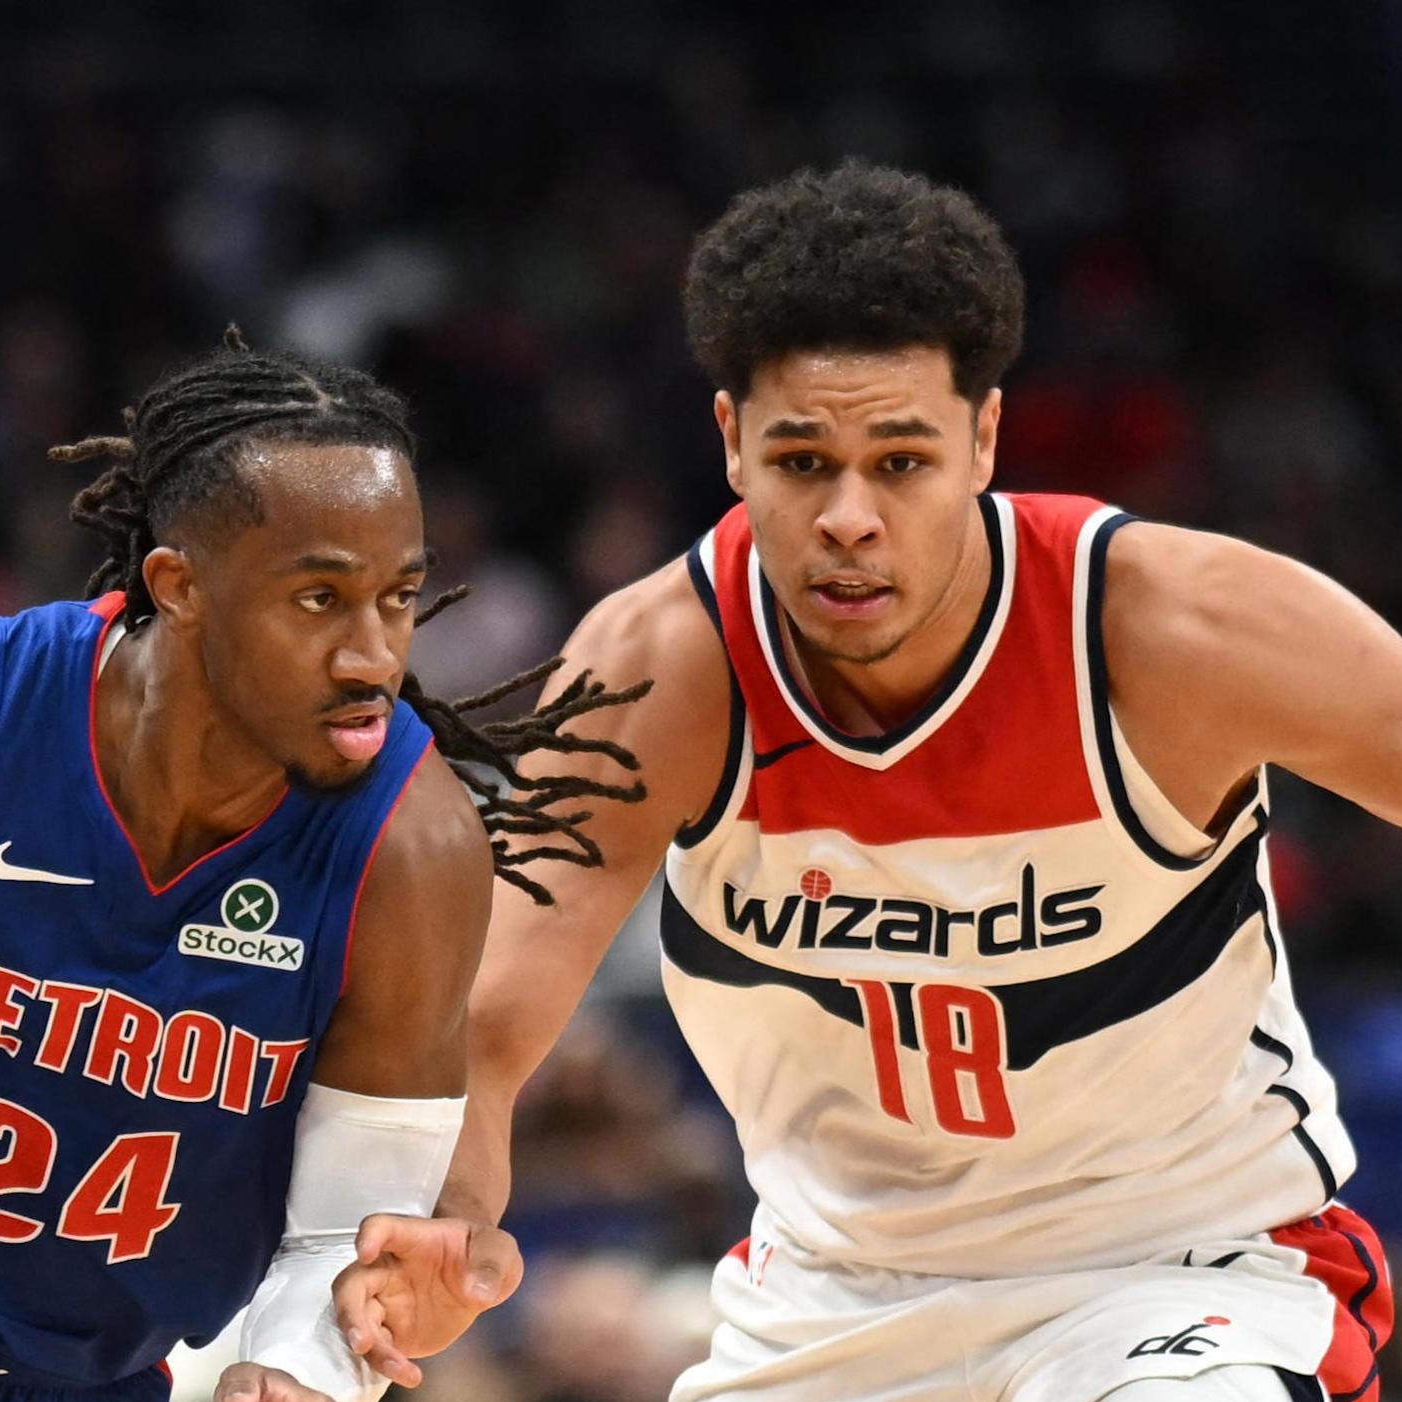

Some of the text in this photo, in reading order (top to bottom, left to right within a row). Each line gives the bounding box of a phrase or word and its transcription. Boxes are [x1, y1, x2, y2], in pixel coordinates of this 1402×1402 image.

[183, 927, 301, 966] StockX
[723, 861, 1106, 958] wizards
[841, 978, 1017, 1140] 18
